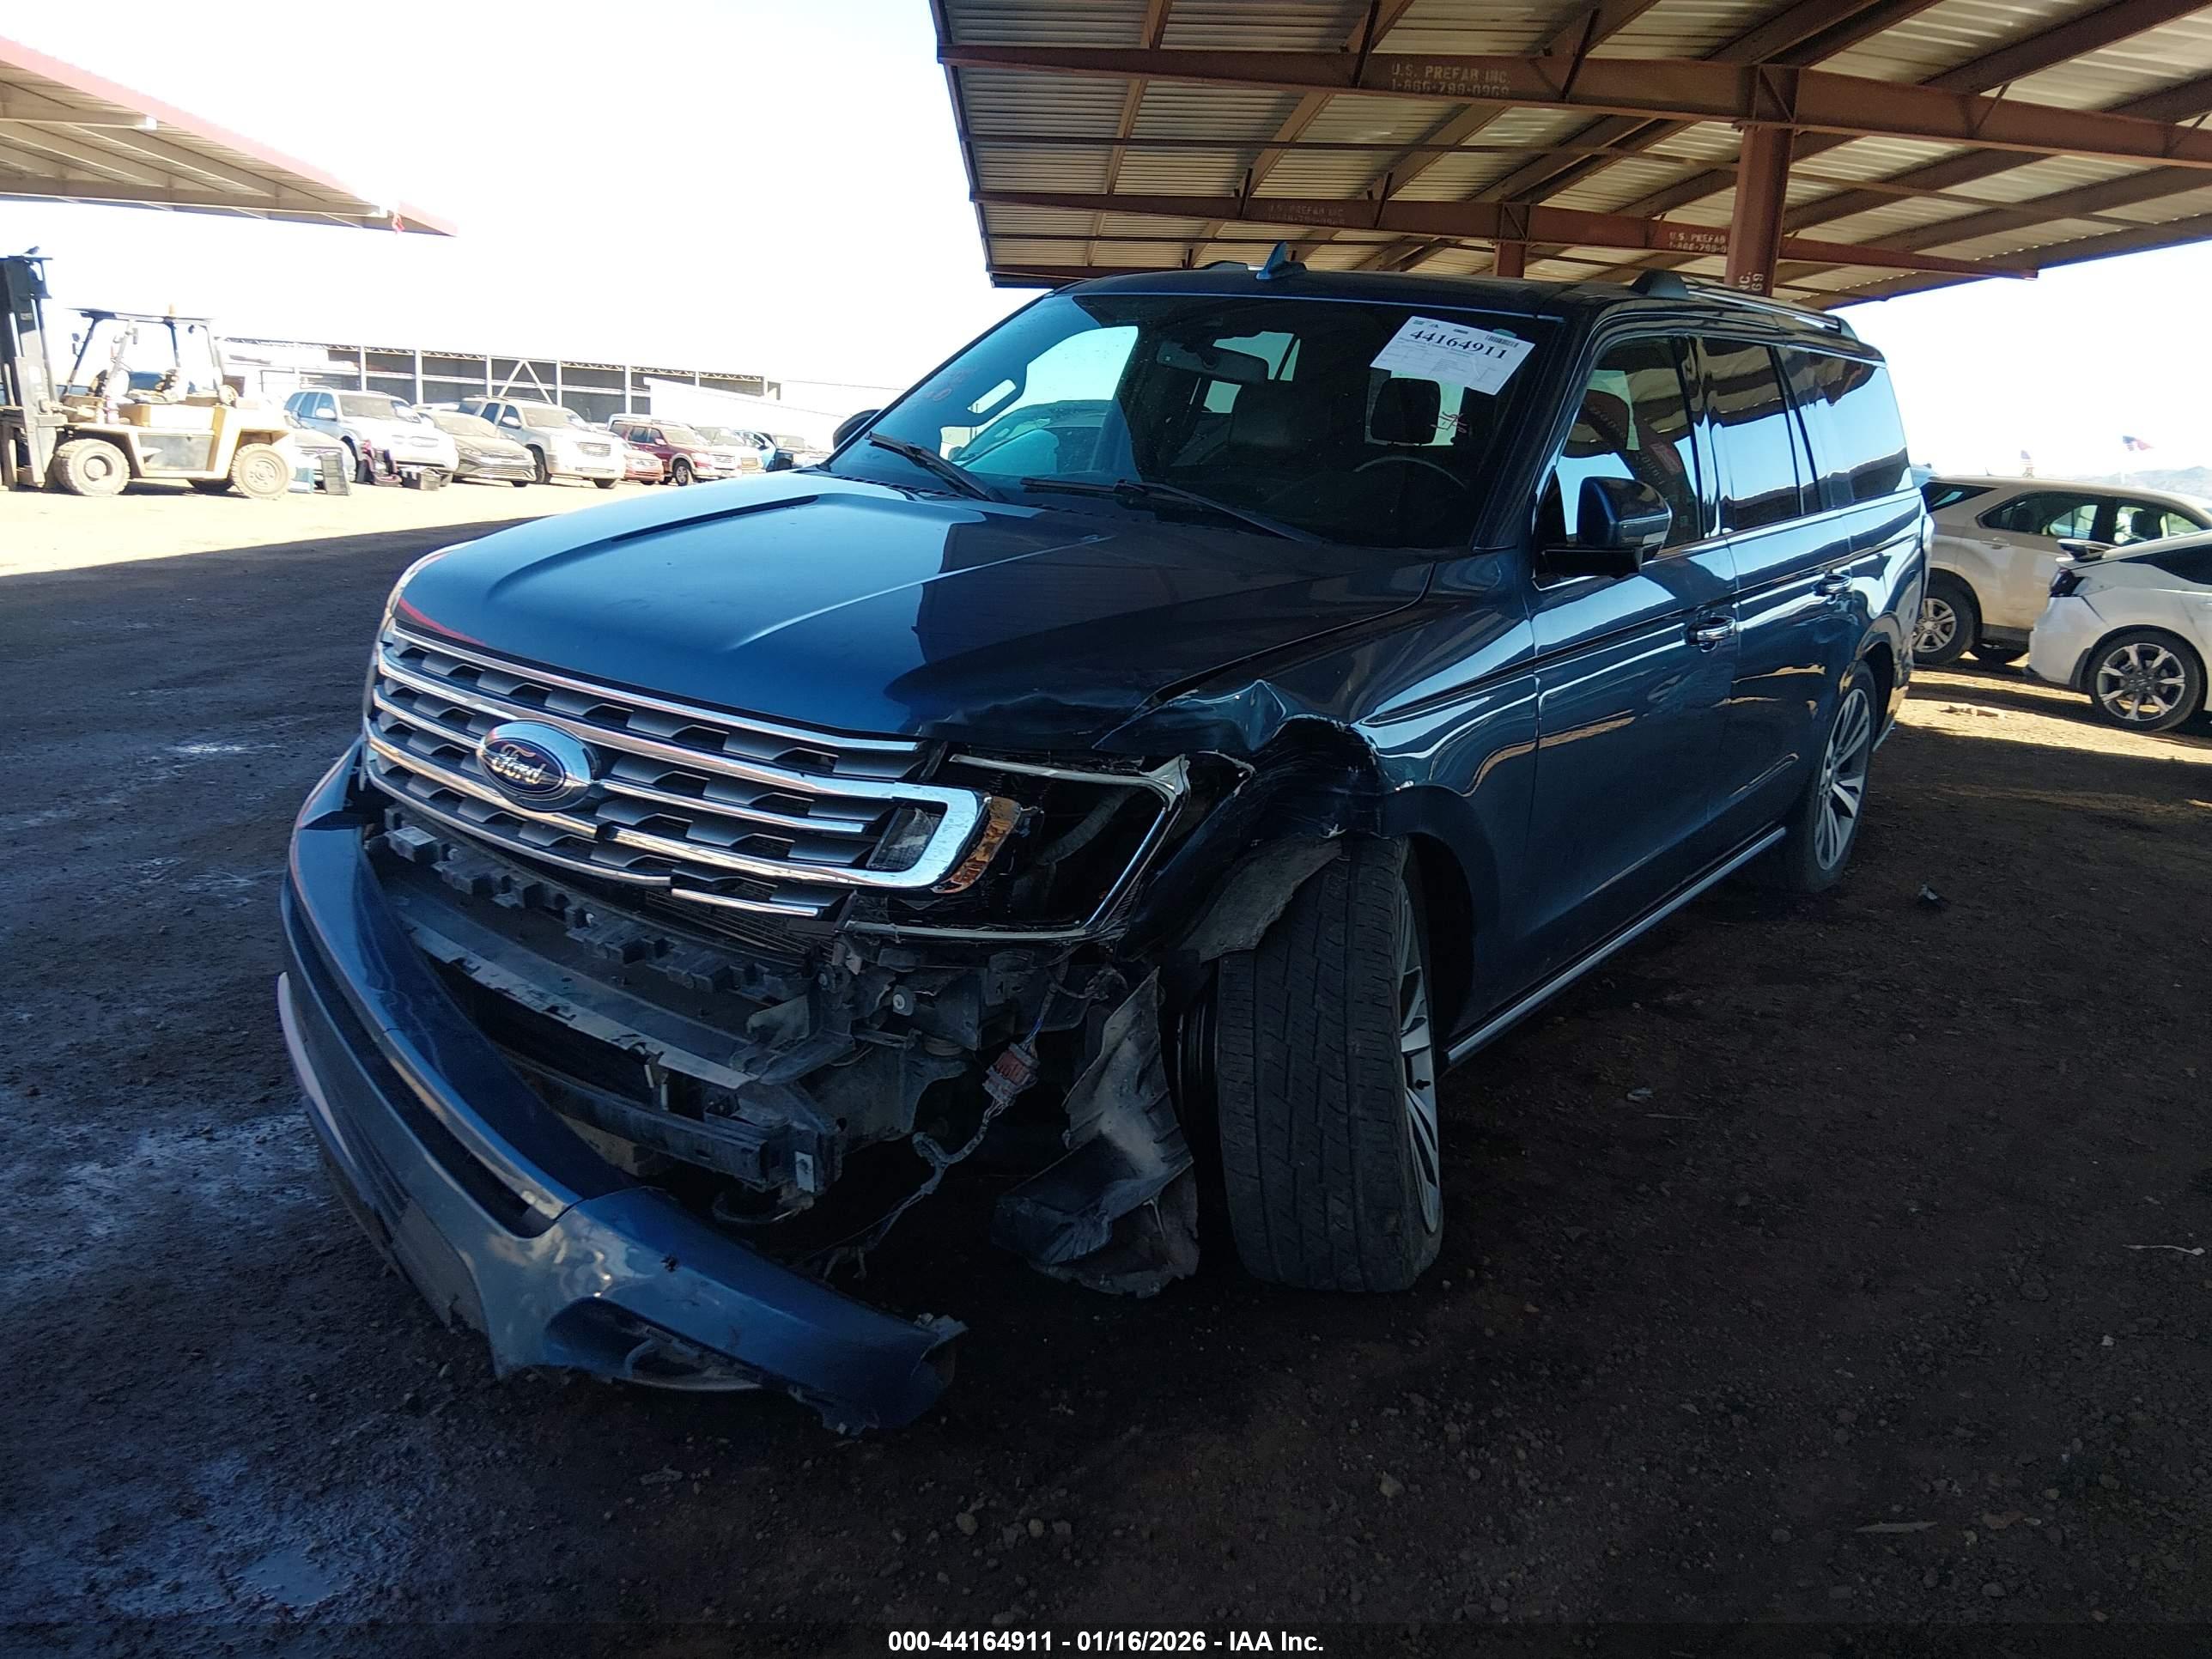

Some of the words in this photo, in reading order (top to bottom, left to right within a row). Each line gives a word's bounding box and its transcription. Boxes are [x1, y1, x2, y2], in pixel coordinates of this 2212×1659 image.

[1391, 62, 1418, 77] U.S.
[1425, 65, 1479, 82] PREFAB
[1485, 69, 1510, 83] INC.
[1691, 233, 1726, 243] PREFAB
[1739, 271, 1752, 290] NC.
[1410, 330, 1507, 359] 44164911
[492, 744, 547, 785] Ford
